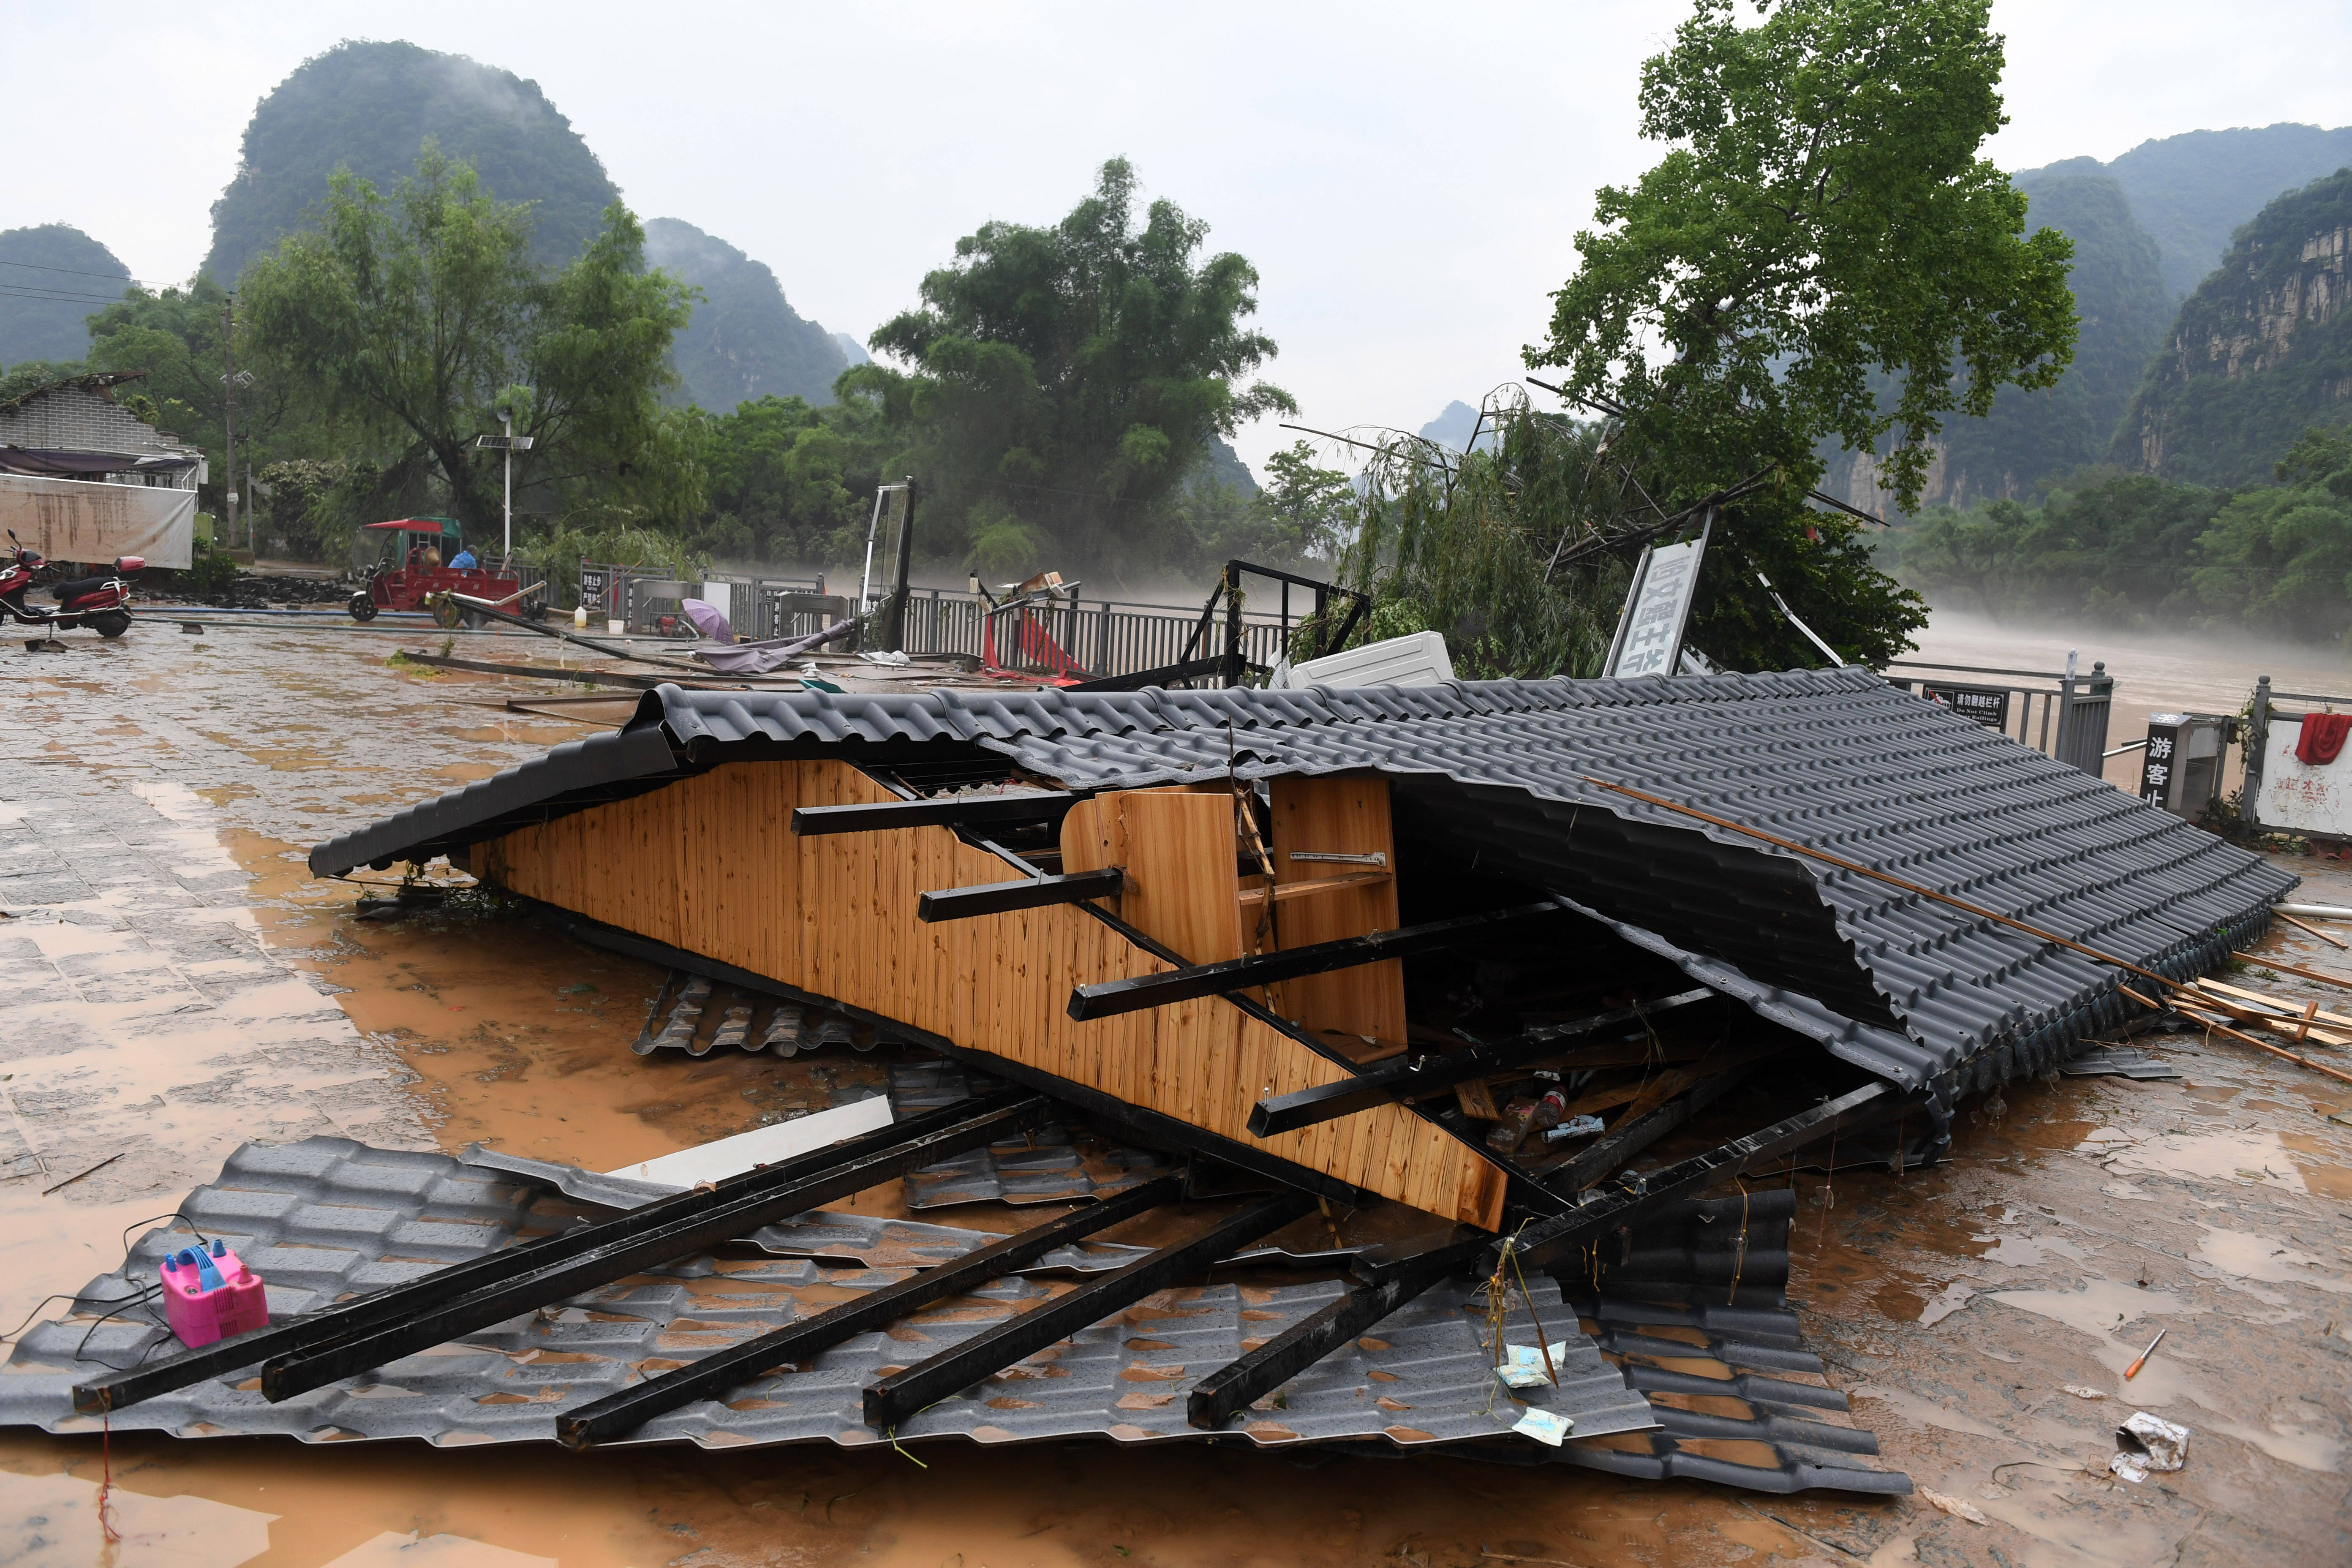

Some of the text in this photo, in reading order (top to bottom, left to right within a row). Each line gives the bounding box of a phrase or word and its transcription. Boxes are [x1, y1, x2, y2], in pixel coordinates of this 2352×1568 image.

[583, 575, 601, 586] 游客止步
[1957, 694, 2000, 709] 请勿翻越栏杆
